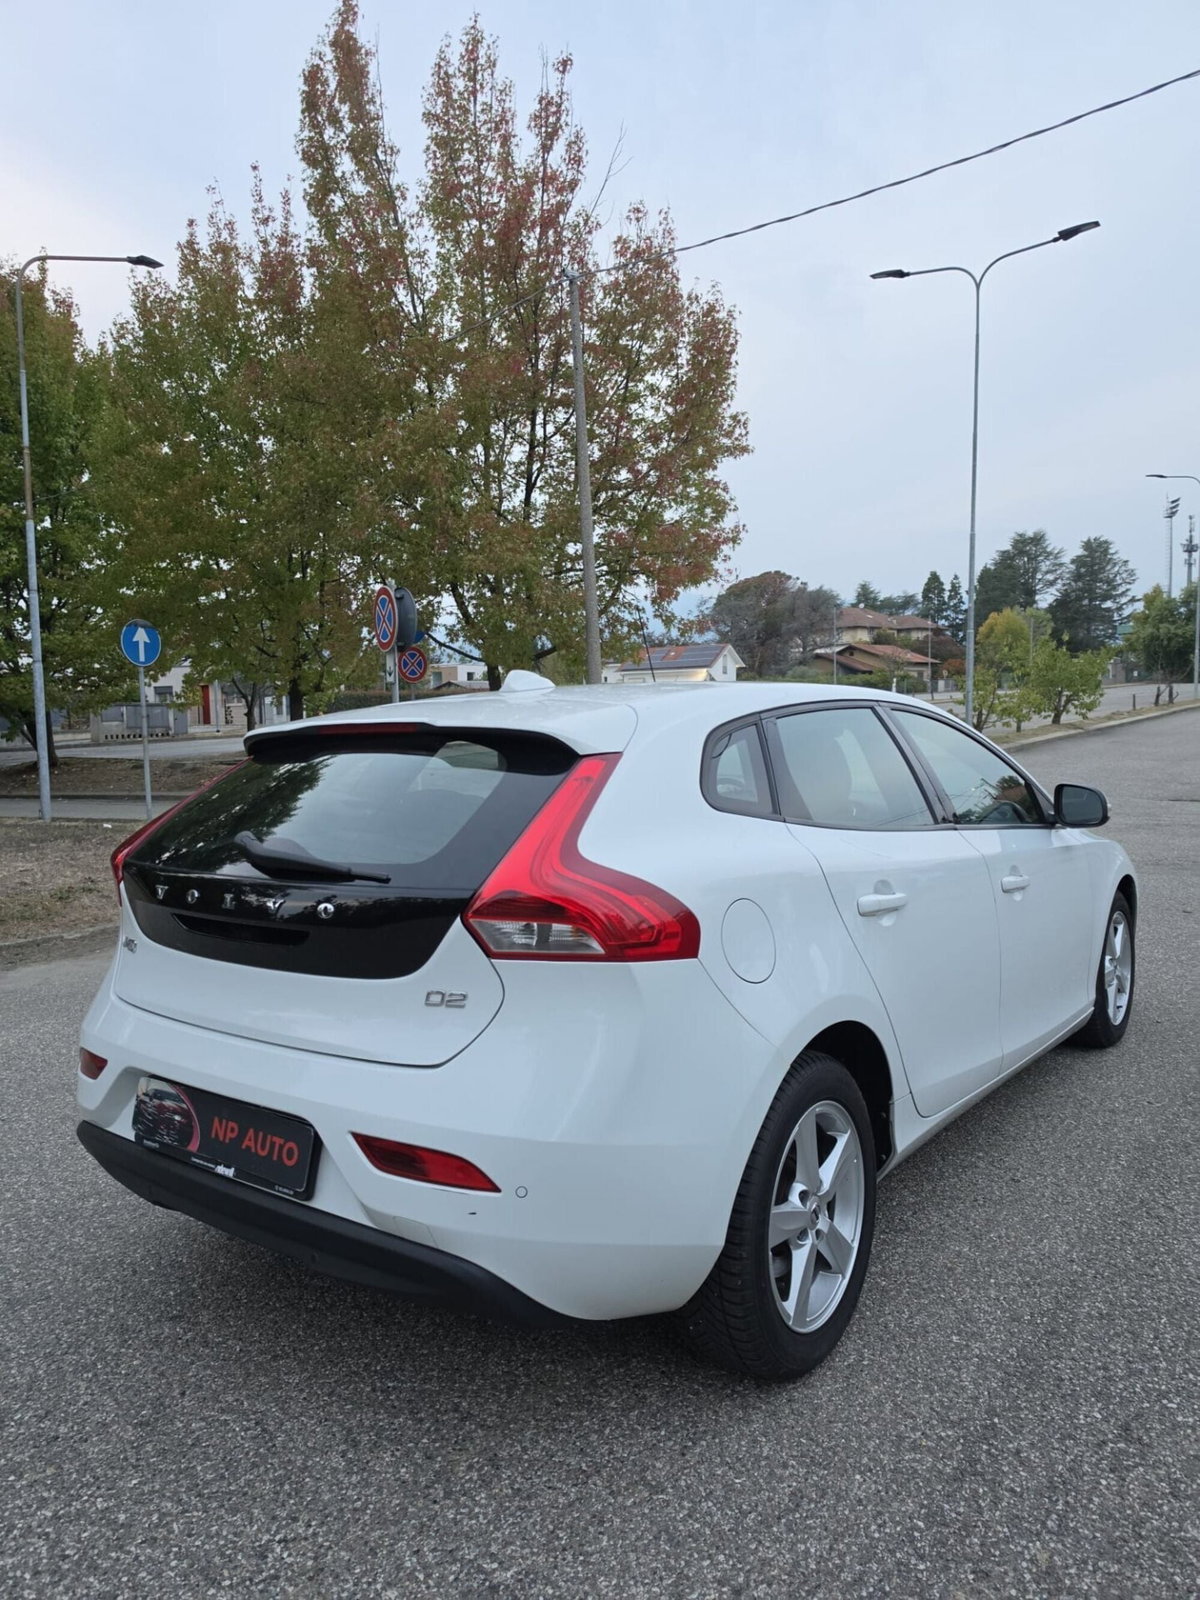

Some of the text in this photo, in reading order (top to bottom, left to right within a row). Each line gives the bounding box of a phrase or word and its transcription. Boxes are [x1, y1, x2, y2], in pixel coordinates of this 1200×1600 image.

[155, 884, 335, 919] VOLVO
[424, 990, 468, 1009] D2
[211, 1116, 240, 1144] NP
[241, 1127, 299, 1167] AUTO
